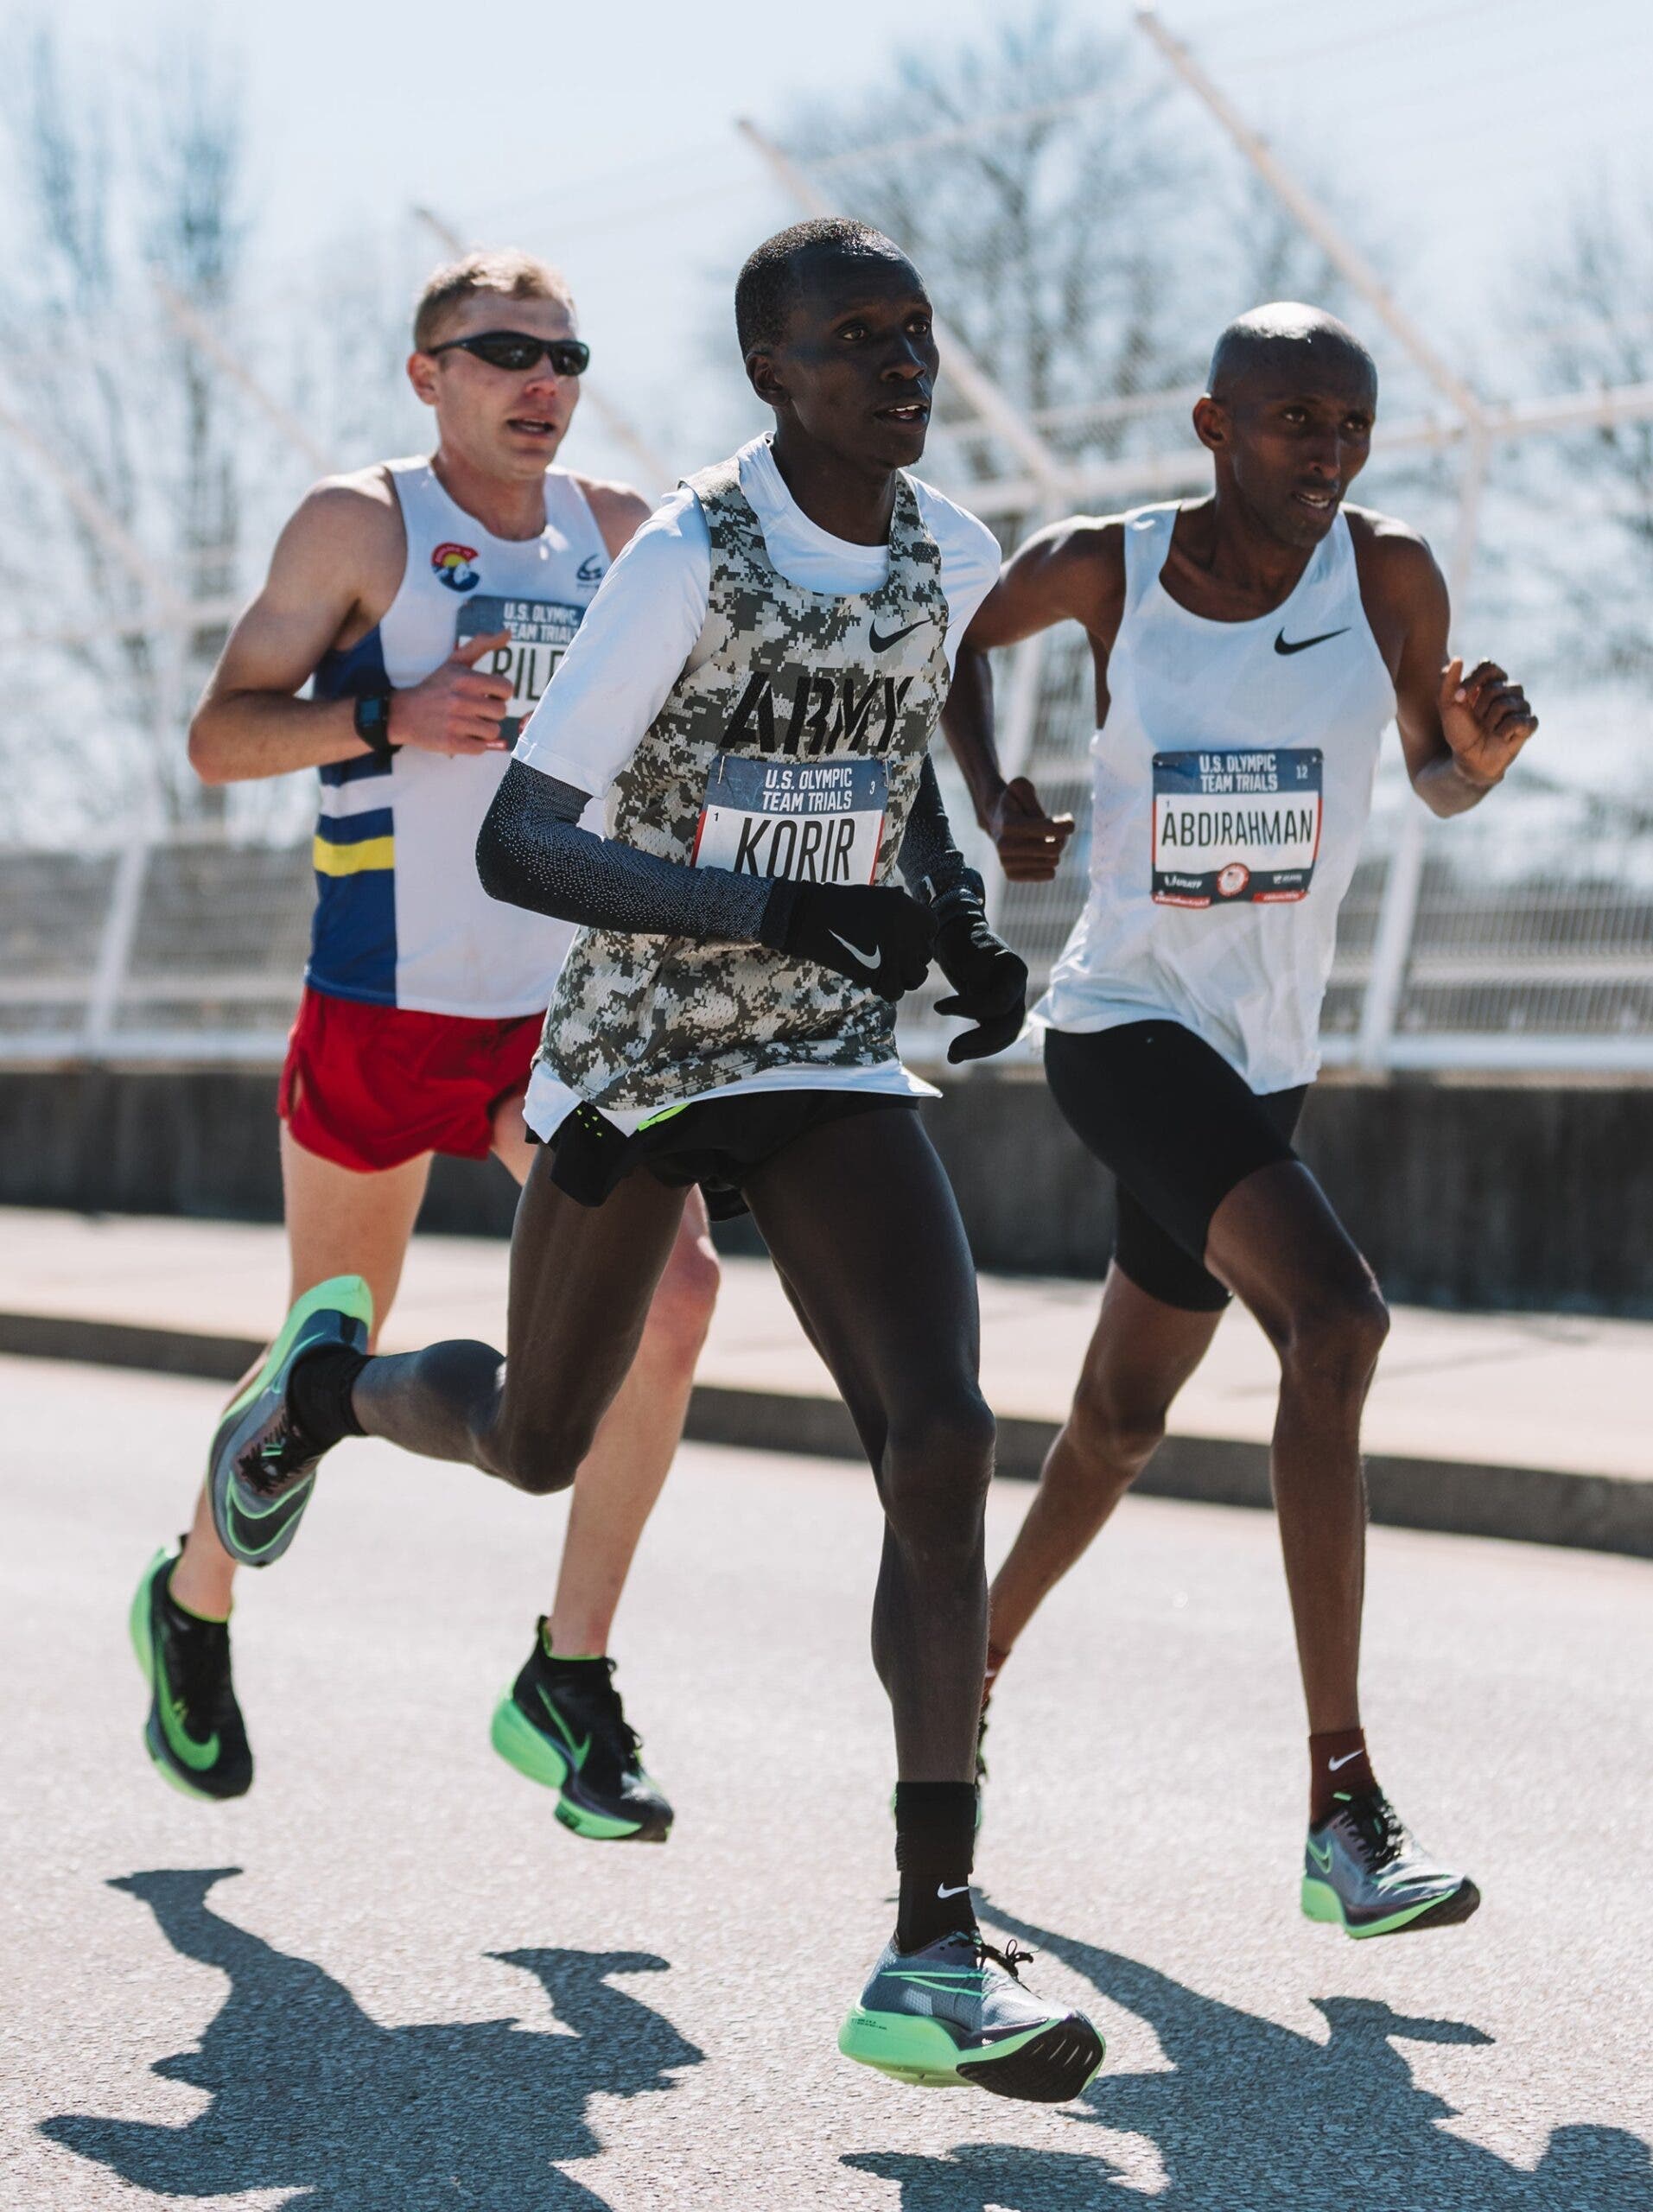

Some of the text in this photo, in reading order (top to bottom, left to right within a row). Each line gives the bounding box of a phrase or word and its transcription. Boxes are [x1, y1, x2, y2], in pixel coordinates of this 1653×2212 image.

[504, 602, 529, 621] U.S.
[540, 625, 579, 645] TRIAL
[719, 672, 914, 755] ARMY
[1199, 753, 1277, 773] U.S. OLYMPIC
[1296, 765, 1308, 779] 12
[765, 767, 853, 790] U.S. OLYMPIC
[869, 780, 876, 795] 3
[1200, 773, 1278, 792] TEAM TRIALS
[762, 791, 853, 811] TEAM TRIALS
[714, 812, 720, 822] 1
[1161, 809, 1313, 848] ABDIRAHMAN
[734, 817, 855, 883] KORIR
